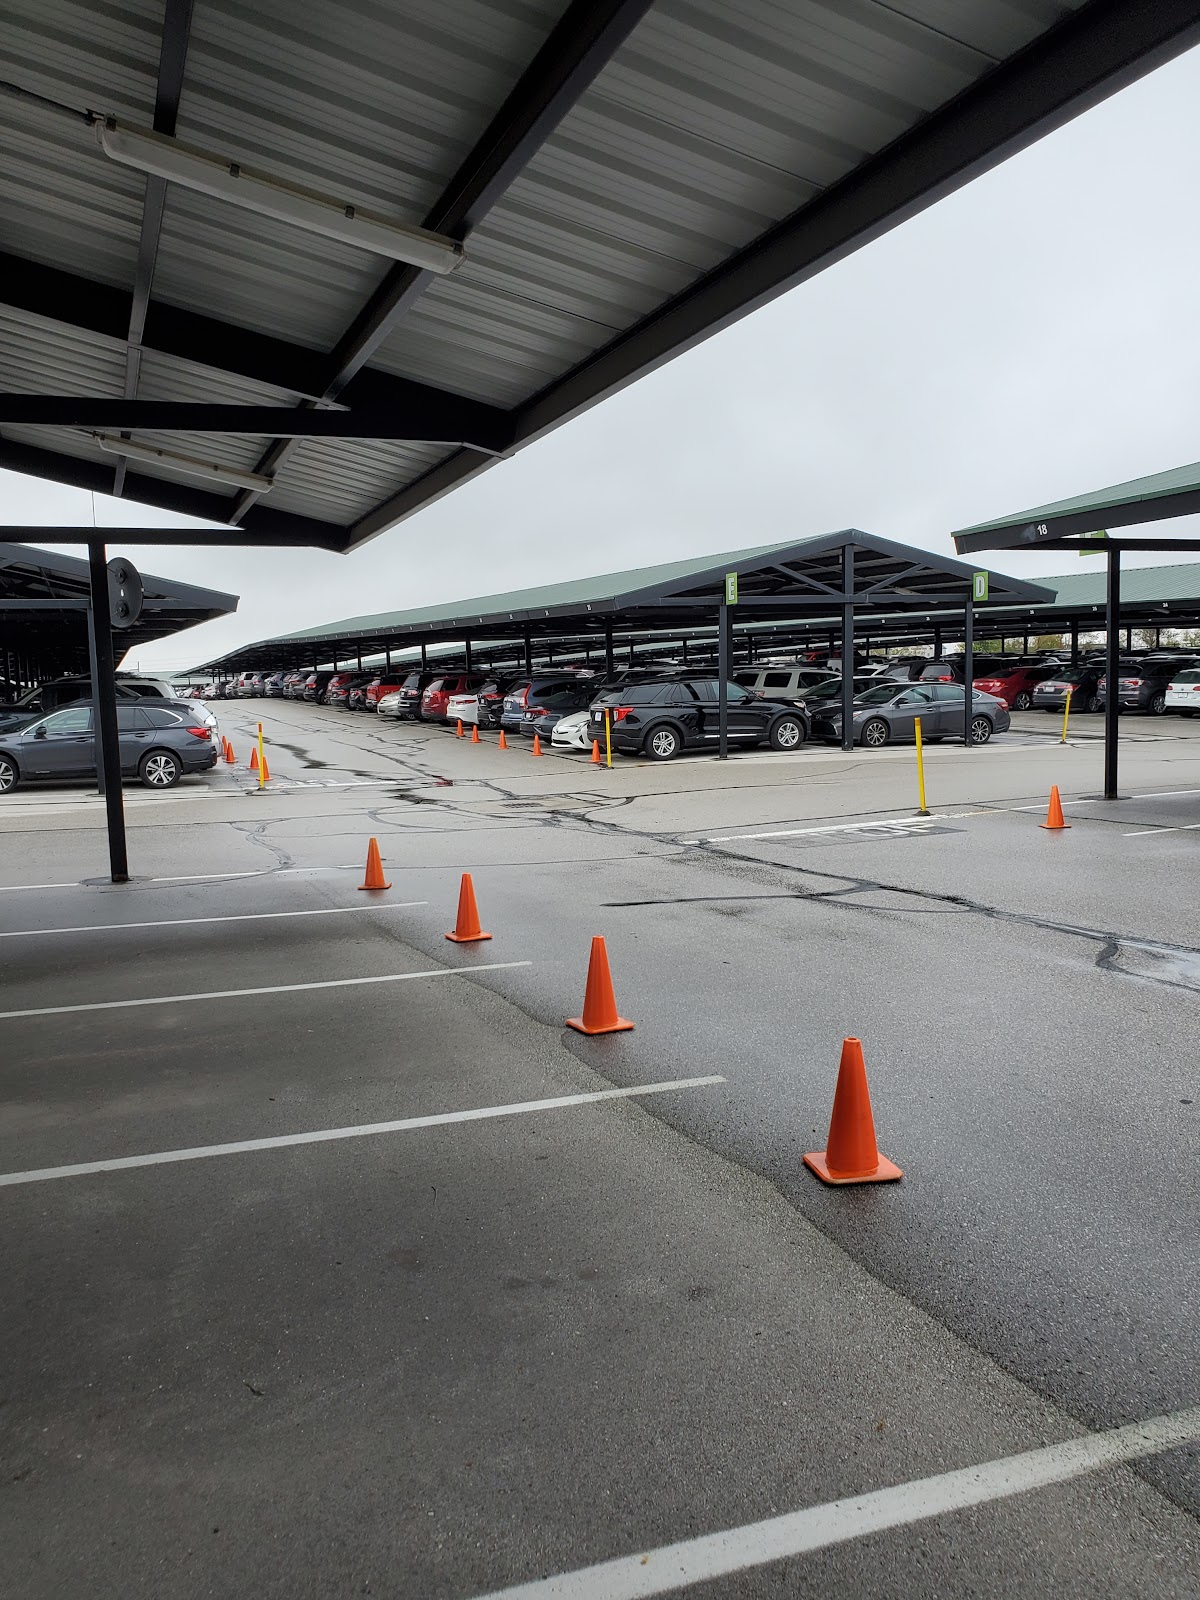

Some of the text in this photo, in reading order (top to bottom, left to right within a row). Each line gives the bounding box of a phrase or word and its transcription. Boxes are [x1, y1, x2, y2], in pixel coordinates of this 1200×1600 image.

[1036, 524, 1048, 536] 18
[727, 577, 735, 601] E
[975, 576, 985, 598] D
